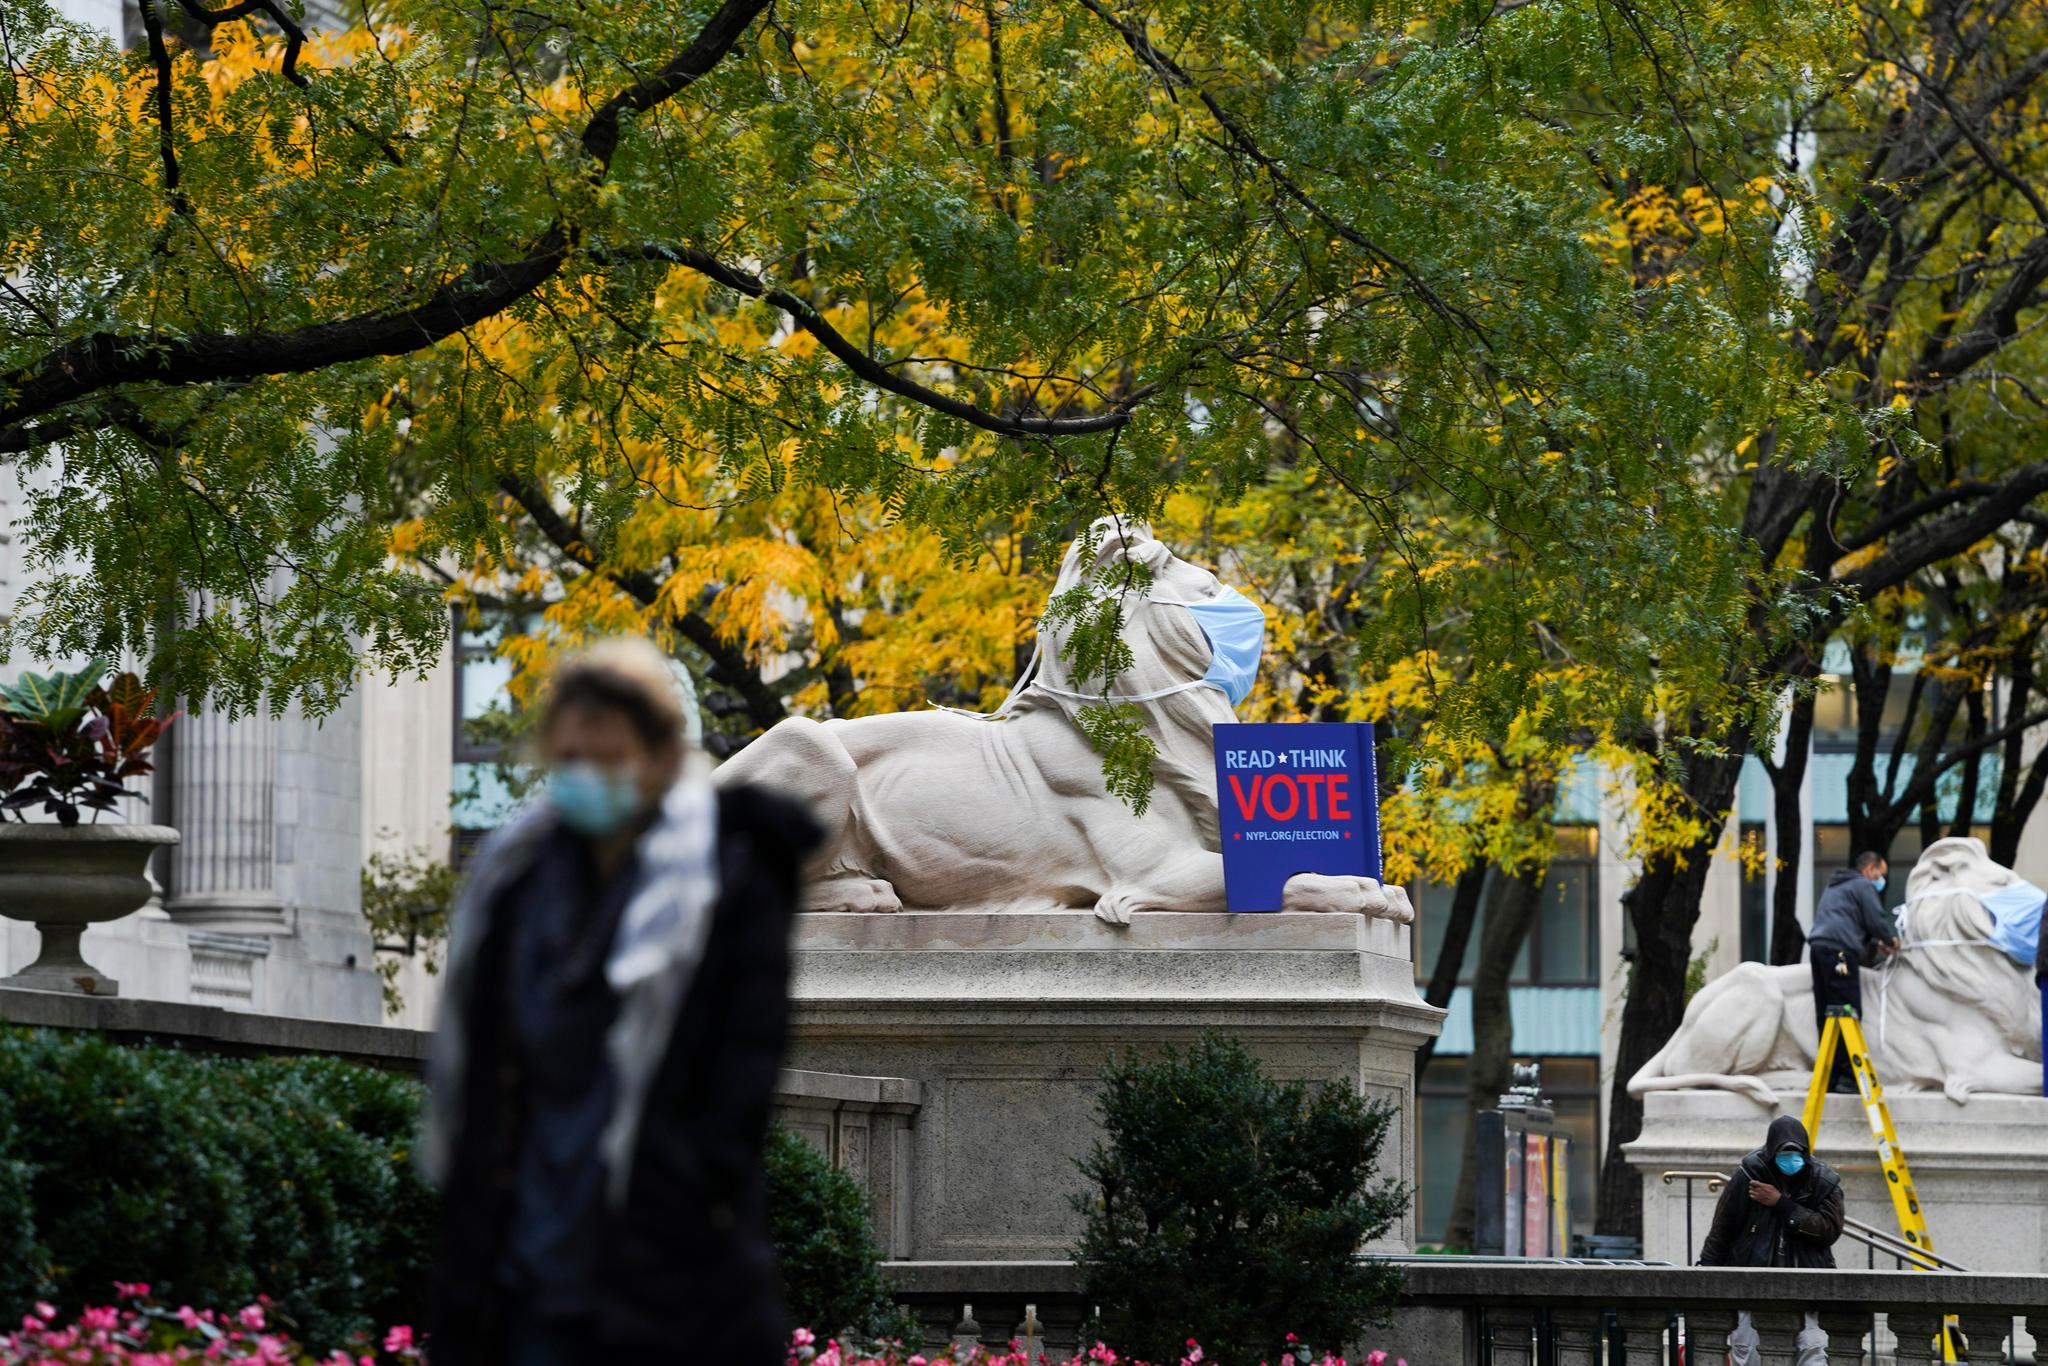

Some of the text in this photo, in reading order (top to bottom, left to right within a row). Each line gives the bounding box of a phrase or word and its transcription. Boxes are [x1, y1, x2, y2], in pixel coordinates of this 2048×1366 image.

[1225, 749, 1347, 769] READ THINK
[1228, 773, 1352, 821] VOTE
[1245, 830, 1341, 842] NYPL.ORG/ELECTION
